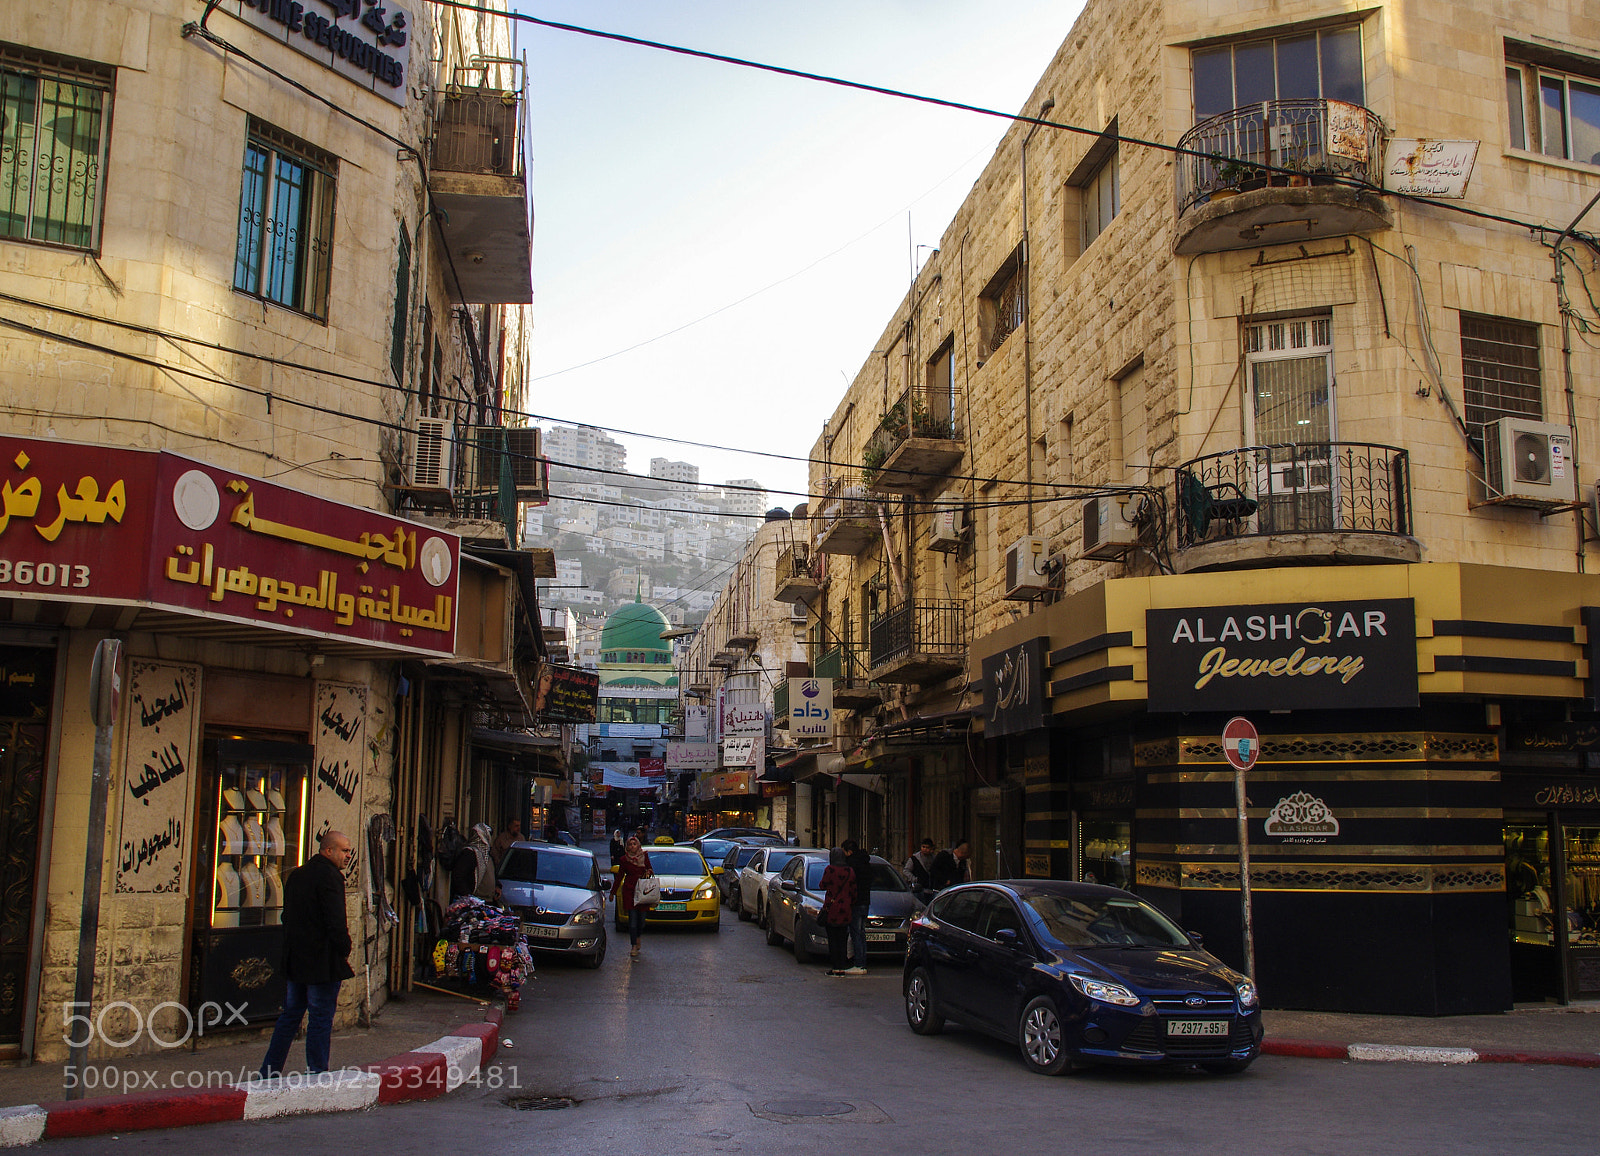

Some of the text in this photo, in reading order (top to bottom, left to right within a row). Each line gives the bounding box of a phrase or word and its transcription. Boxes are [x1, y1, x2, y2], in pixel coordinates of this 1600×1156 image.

[303, 11, 404, 88] SECURITIES
[0, 450, 126, 541] معرض
[165, 543, 452, 637] للصياغة والمجوهرات
[1172, 607, 1388, 645] ALASHQAR
[1194, 646, 1364, 690] Jewelery
[133, 677, 189, 733] المحبة
[321, 692, 361, 744] المحبة
[128, 742, 185, 806] للذهب
[318, 756, 360, 805] للذهب
[122, 816, 181, 874] والمجوهرات
